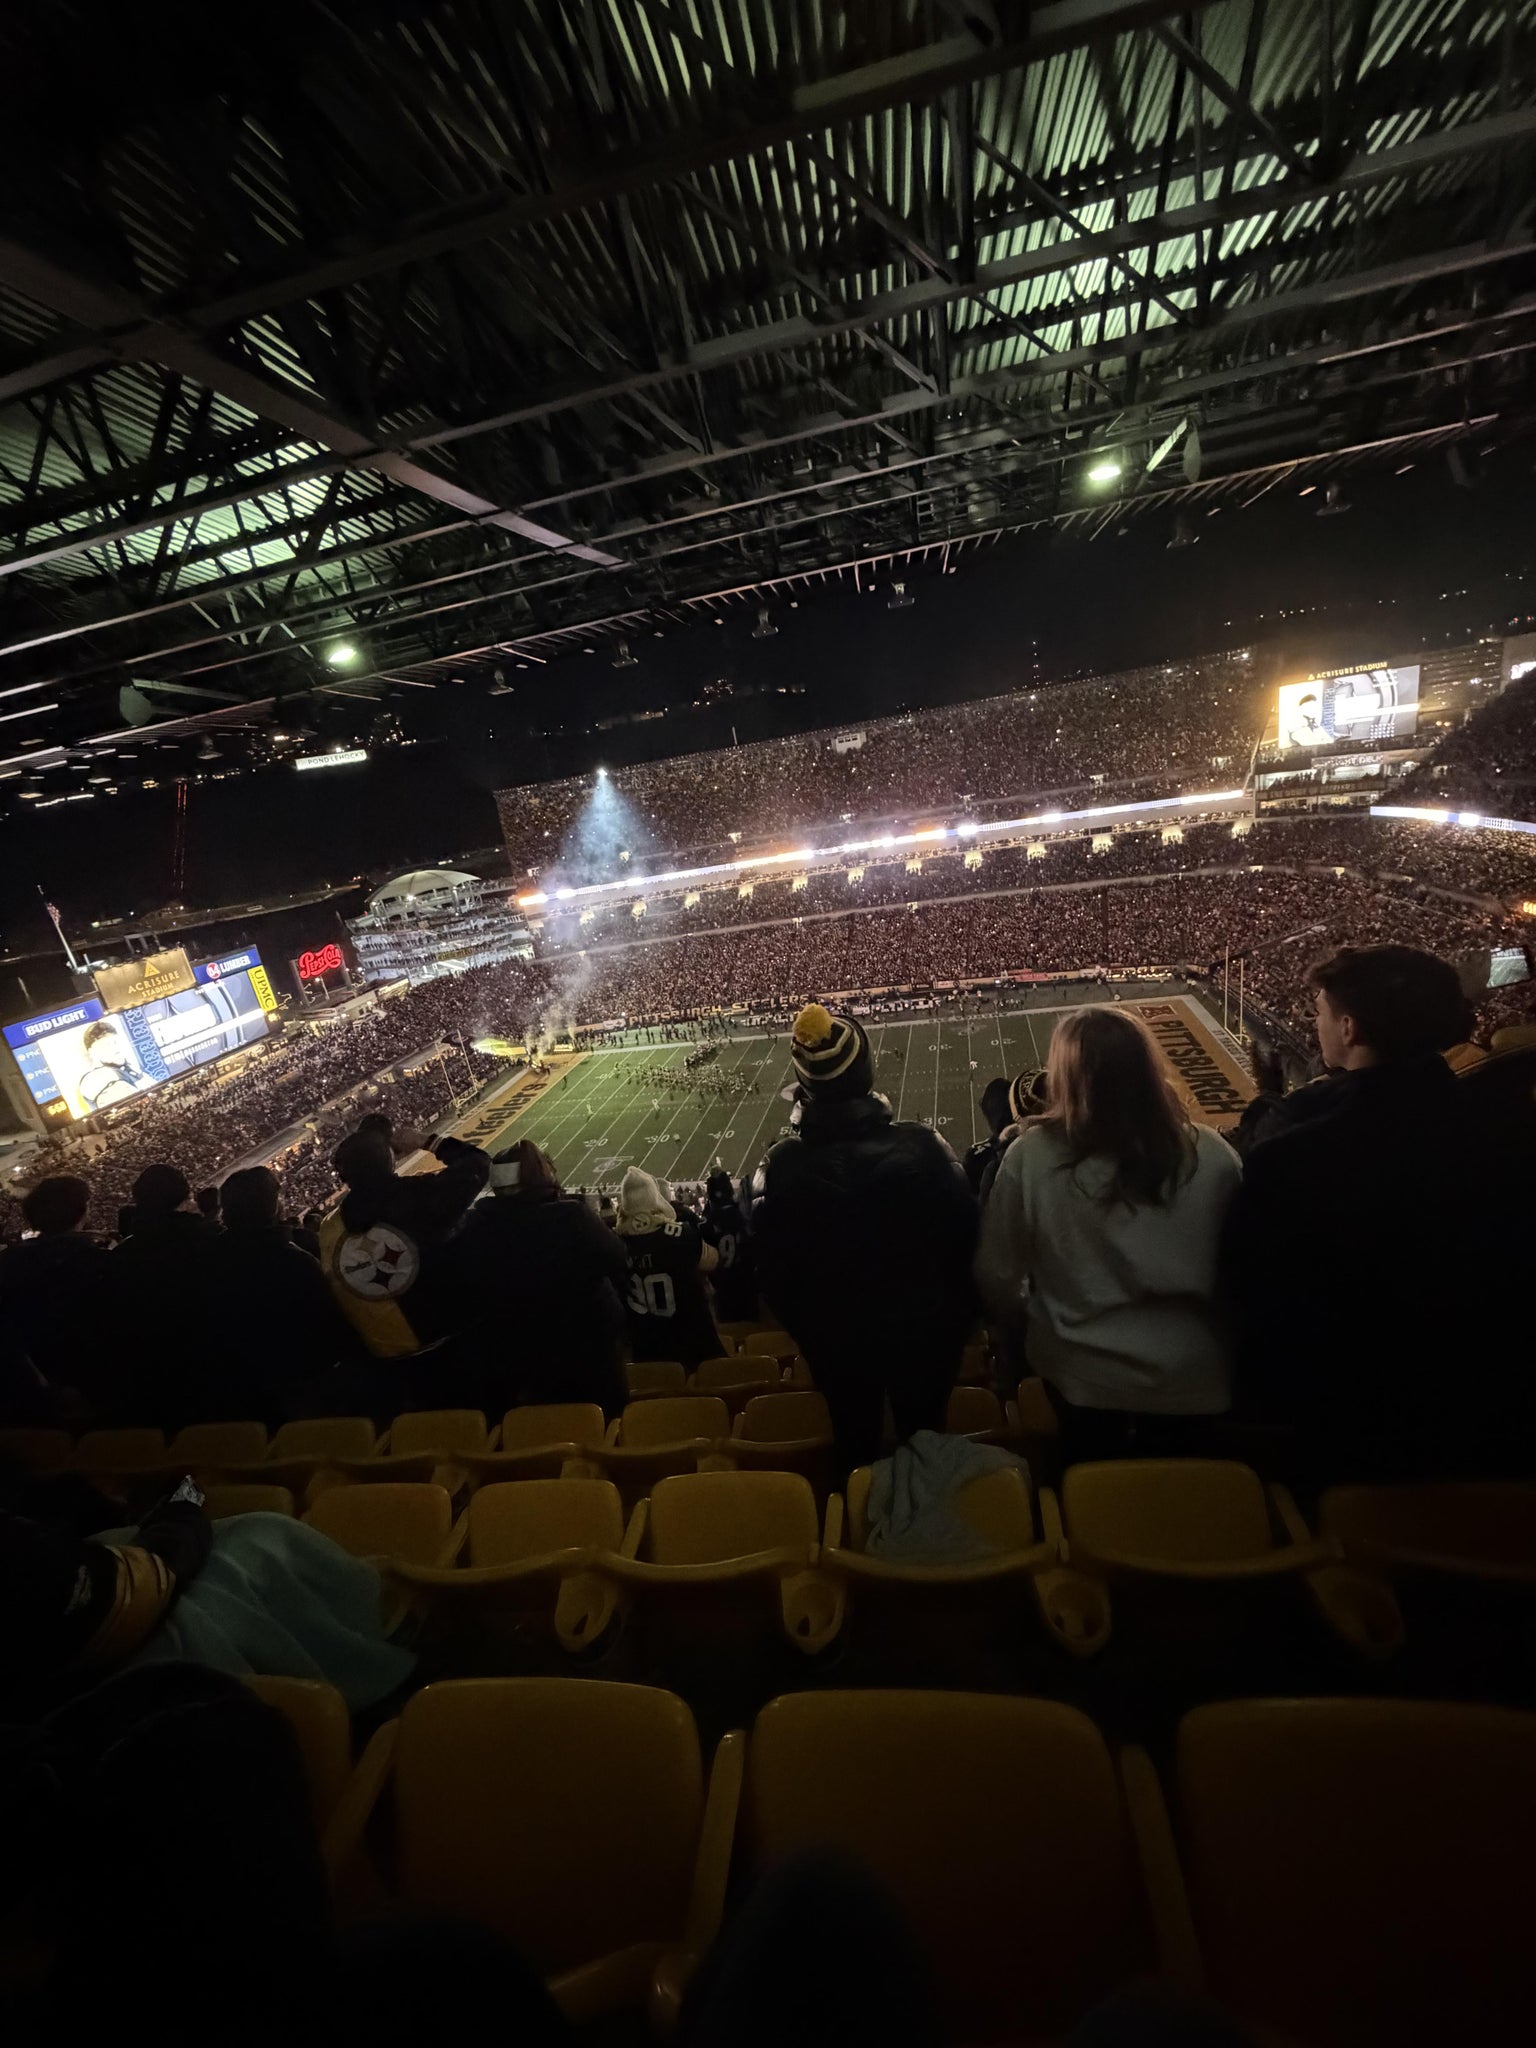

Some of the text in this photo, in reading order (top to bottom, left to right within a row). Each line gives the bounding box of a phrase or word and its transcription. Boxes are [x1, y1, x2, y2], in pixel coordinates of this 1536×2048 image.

[1316, 661, 1388, 679] ACRISURE STADIUM
[308, 756, 330, 765] POND
[220, 955, 251, 973] LUMBER
[128, 970, 180, 994] ACRISURE
[141, 982, 175, 998] STADIUM
[254, 968, 276, 1010] UPMC
[25, 1009, 86, 1036] BUD LIGHT
[1147, 1019, 1249, 1114] PITTSBURGH
